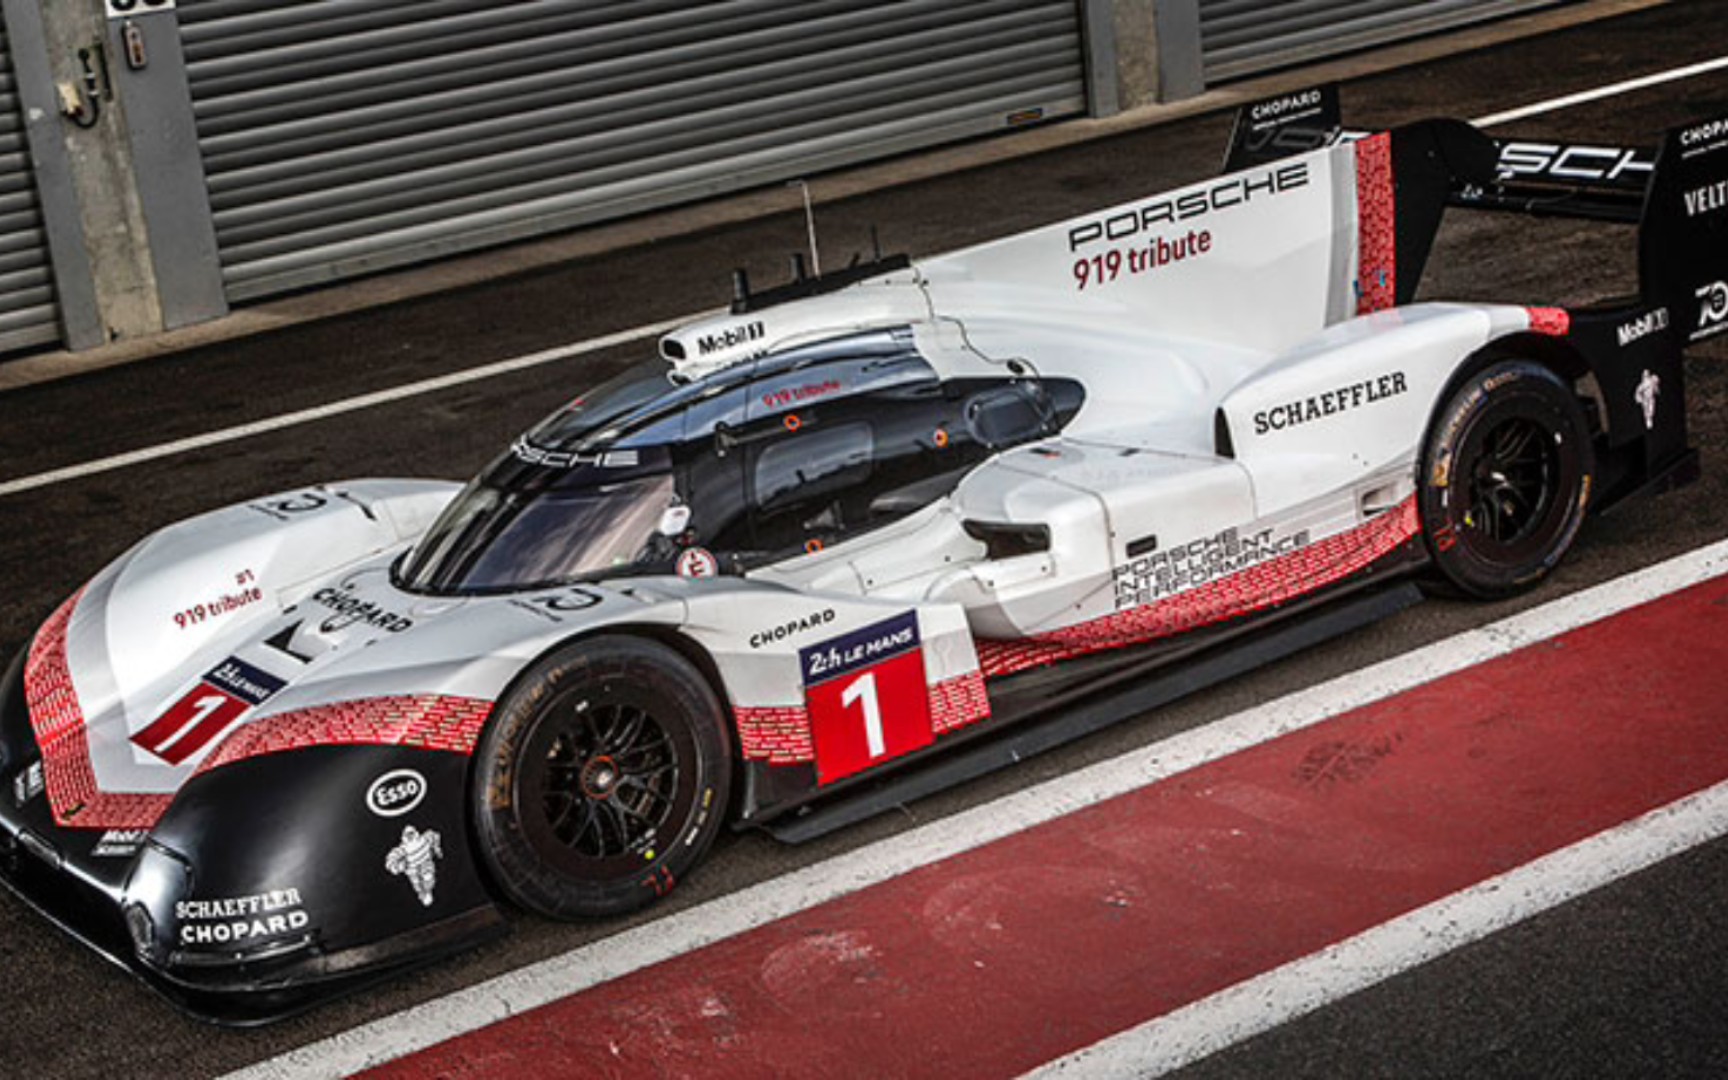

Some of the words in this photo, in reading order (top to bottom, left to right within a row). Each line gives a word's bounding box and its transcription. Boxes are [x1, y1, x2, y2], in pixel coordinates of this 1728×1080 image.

[1252, 90, 1321, 119] CHOPARD
[1069, 162, 1309, 252] PORSCHE
[1073, 249, 1122, 291] 919
[1127, 229, 1212, 274] tribute
[1254, 371, 1408, 435] SCHAEFFLER
[174, 604, 206, 630] 919
[207, 587, 263, 616] tribute
[750, 608, 836, 649] CHOPARD
[844, 644, 865, 663] LE
[154, 695, 228, 751] 1
[841, 671, 886, 760] 1
[176, 888, 302, 919] SCHAEFFLER
[181, 910, 309, 943] CHOPARD
